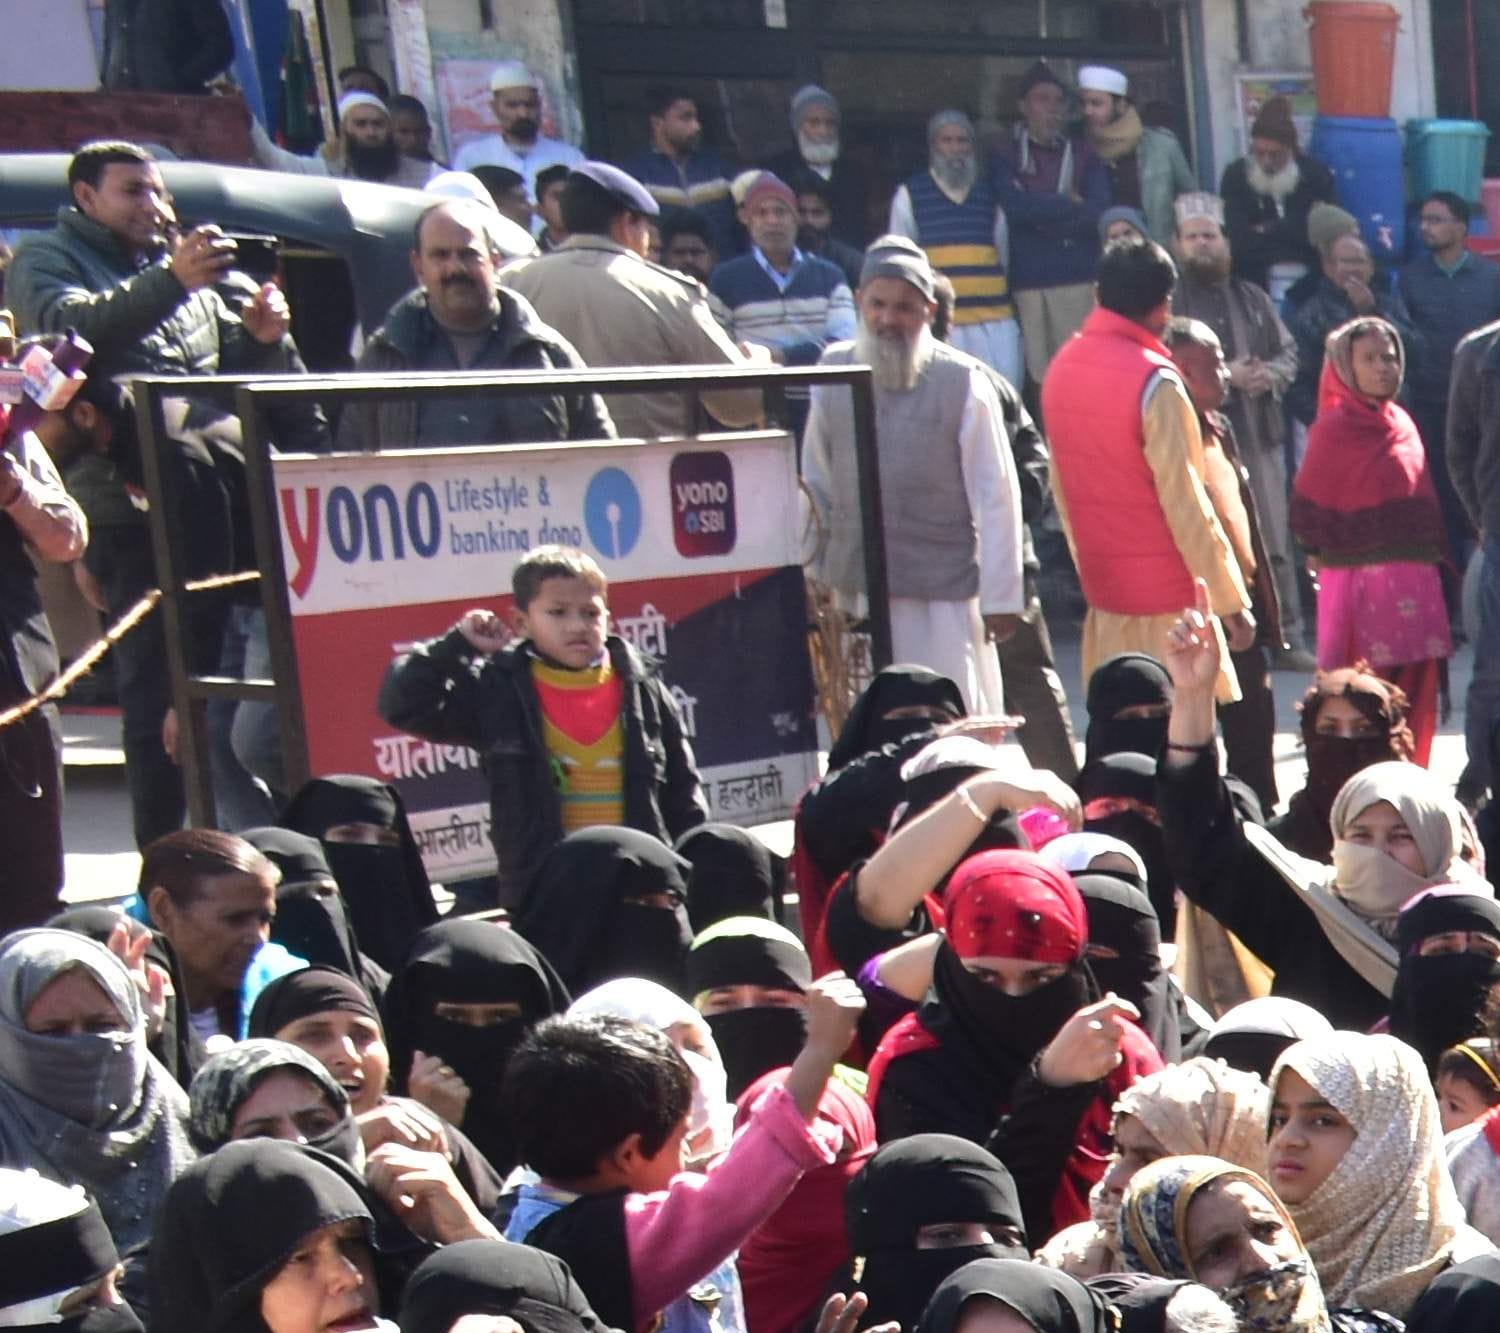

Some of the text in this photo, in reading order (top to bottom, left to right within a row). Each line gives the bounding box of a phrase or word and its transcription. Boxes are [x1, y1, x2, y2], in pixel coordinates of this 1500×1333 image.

[445, 476, 551, 514] Lifestyle &
[676, 481, 728, 512] yono
[450, 521, 530, 555] banking
[699, 509, 725, 534] SBI
[279, 481, 442, 600] yono
